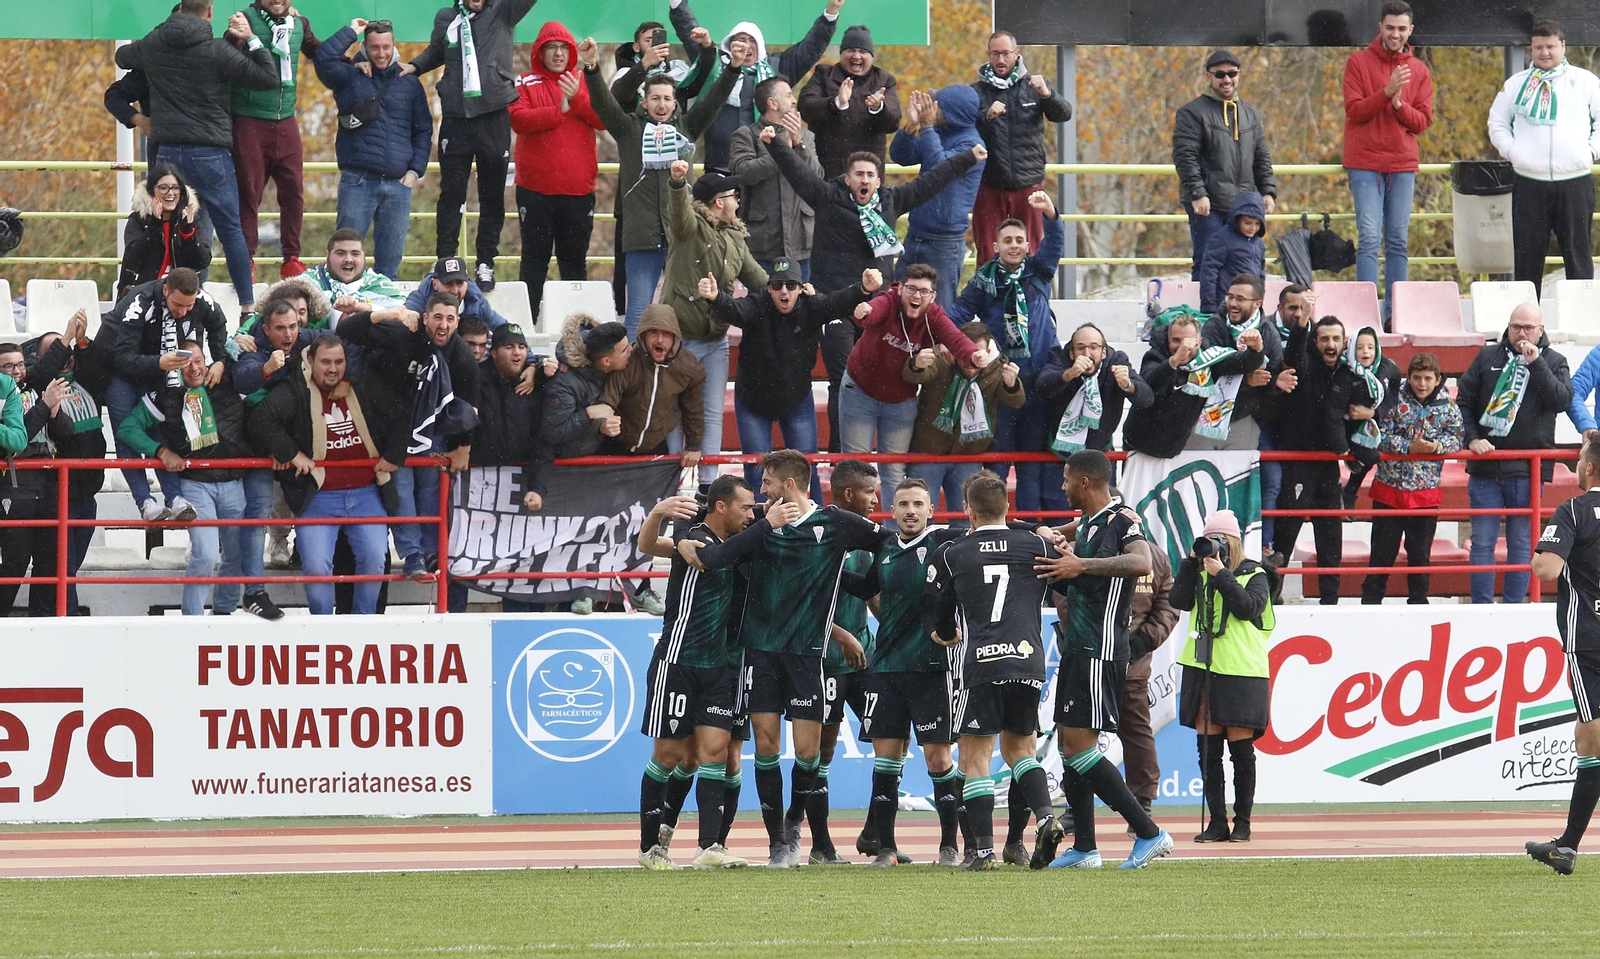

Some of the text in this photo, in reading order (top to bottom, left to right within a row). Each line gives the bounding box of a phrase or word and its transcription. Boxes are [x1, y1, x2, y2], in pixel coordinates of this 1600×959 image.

[326, 435, 362, 450] adida
[978, 540, 1008, 553] ZELU
[983, 564, 1010, 623] 7
[198, 643, 468, 686] FUNERARIA
[825, 677, 837, 701] 8
[1253, 621, 1573, 756] Cedep
[541, 707, 603, 718] FARMACÉUTICOS
[668, 691, 688, 718] 10
[706, 705, 733, 717] efficold
[864, 692, 879, 717] 17
[199, 705, 465, 750] TANATORIO
[191, 772, 473, 796] www.funerariatanesa.es
